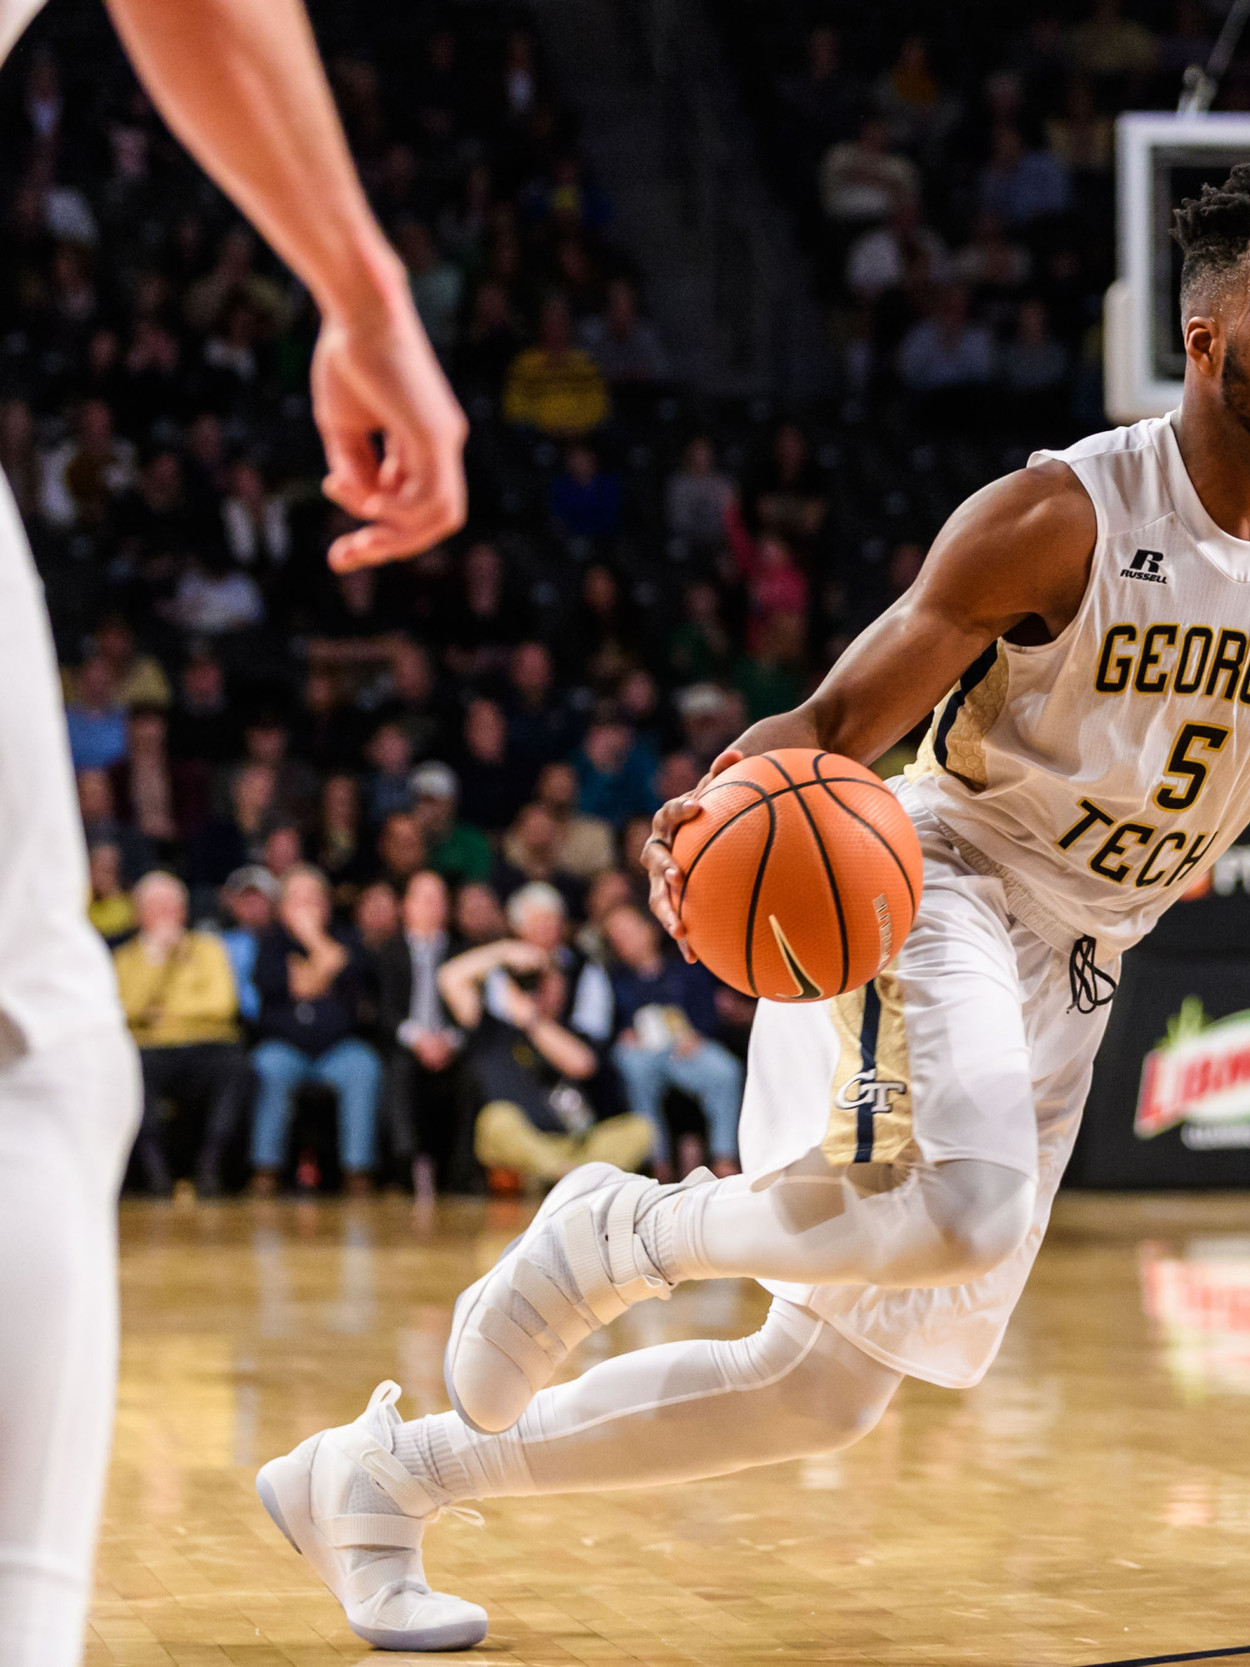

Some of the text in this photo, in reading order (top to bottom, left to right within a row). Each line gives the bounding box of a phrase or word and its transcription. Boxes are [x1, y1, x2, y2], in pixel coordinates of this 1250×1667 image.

[1120, 569, 1167, 584] RUSSELL
[1154, 720, 1233, 812] 5
[1056, 797, 1219, 888] TECH
[834, 1067, 907, 1114] GT
